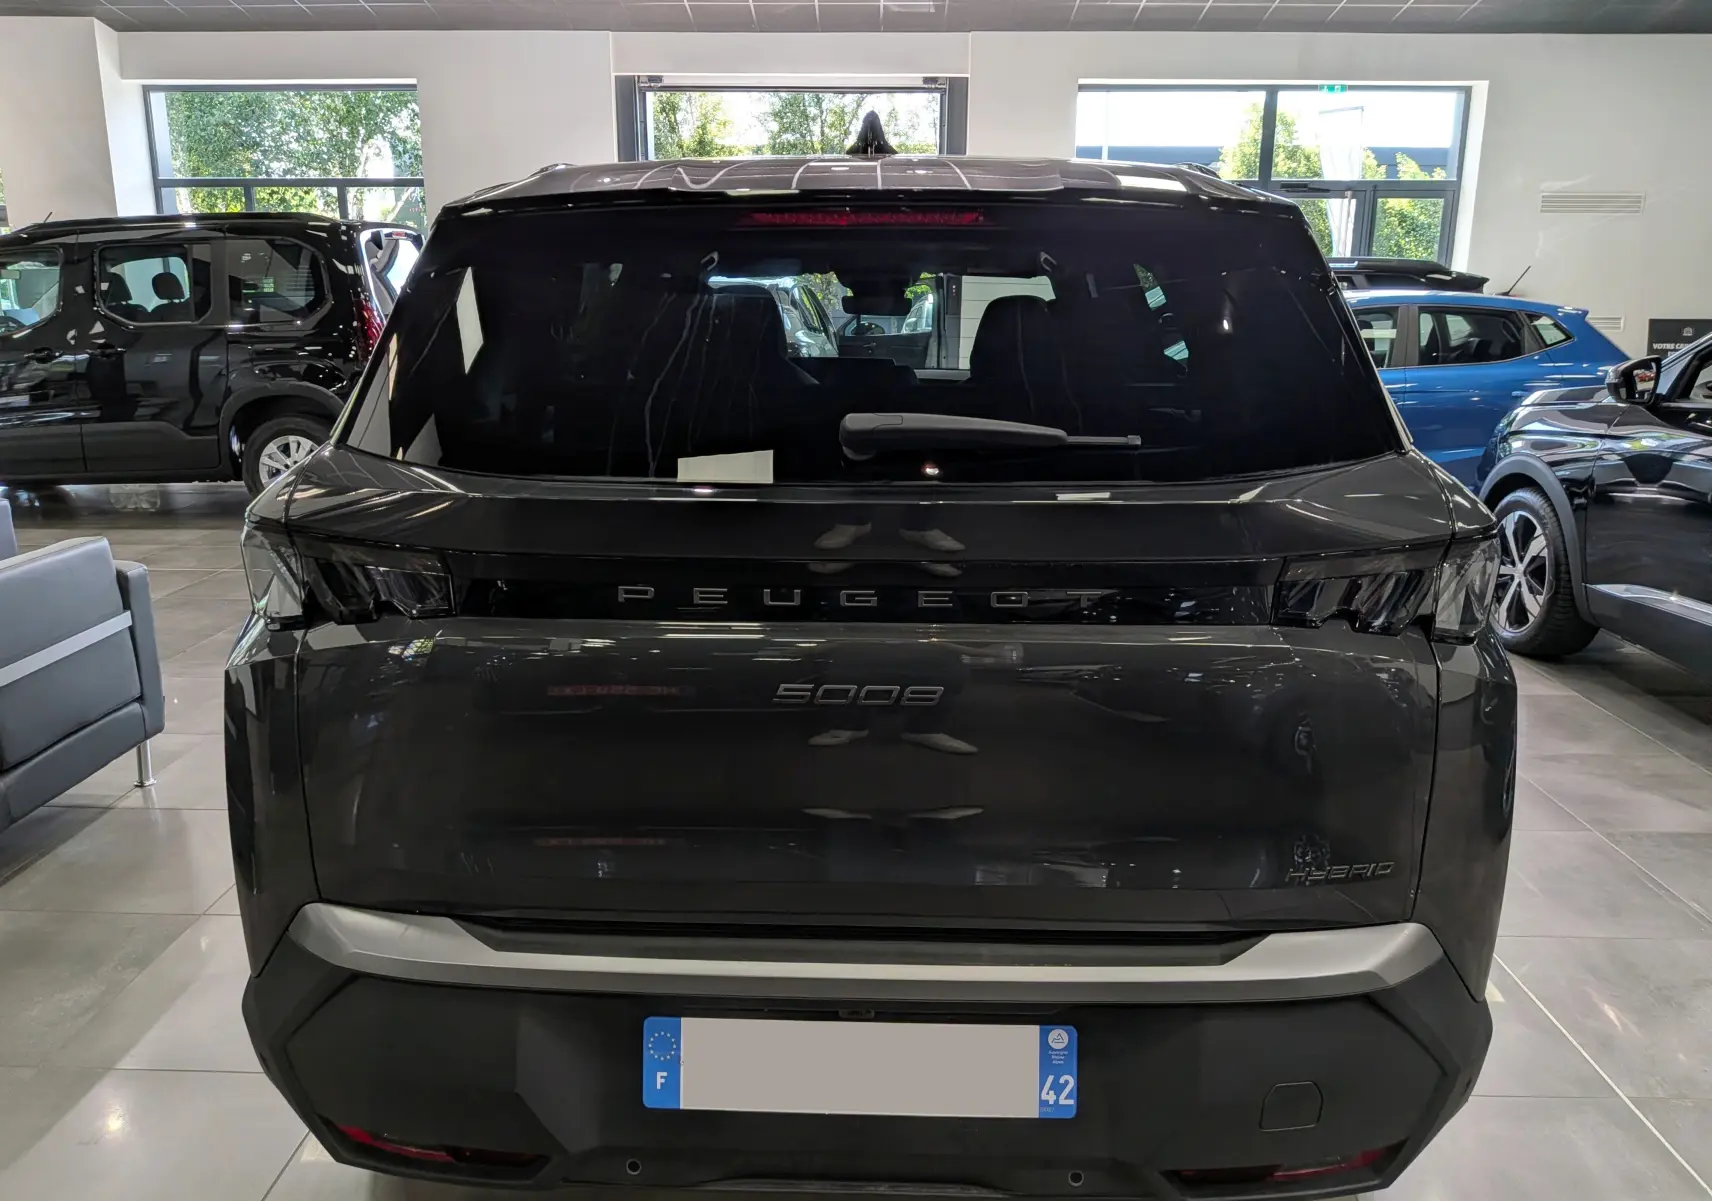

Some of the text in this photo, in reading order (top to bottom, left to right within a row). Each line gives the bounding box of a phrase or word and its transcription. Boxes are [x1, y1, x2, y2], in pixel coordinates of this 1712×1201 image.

[1652, 342, 1675, 350] VOTRE
[617, 585, 1103, 609] PEUGEOT
[772, 683, 945, 706] 5008
[1285, 862, 1395, 883] HYBRID
[656, 1071, 668, 1090] F
[1041, 1074, 1075, 1105] 42
